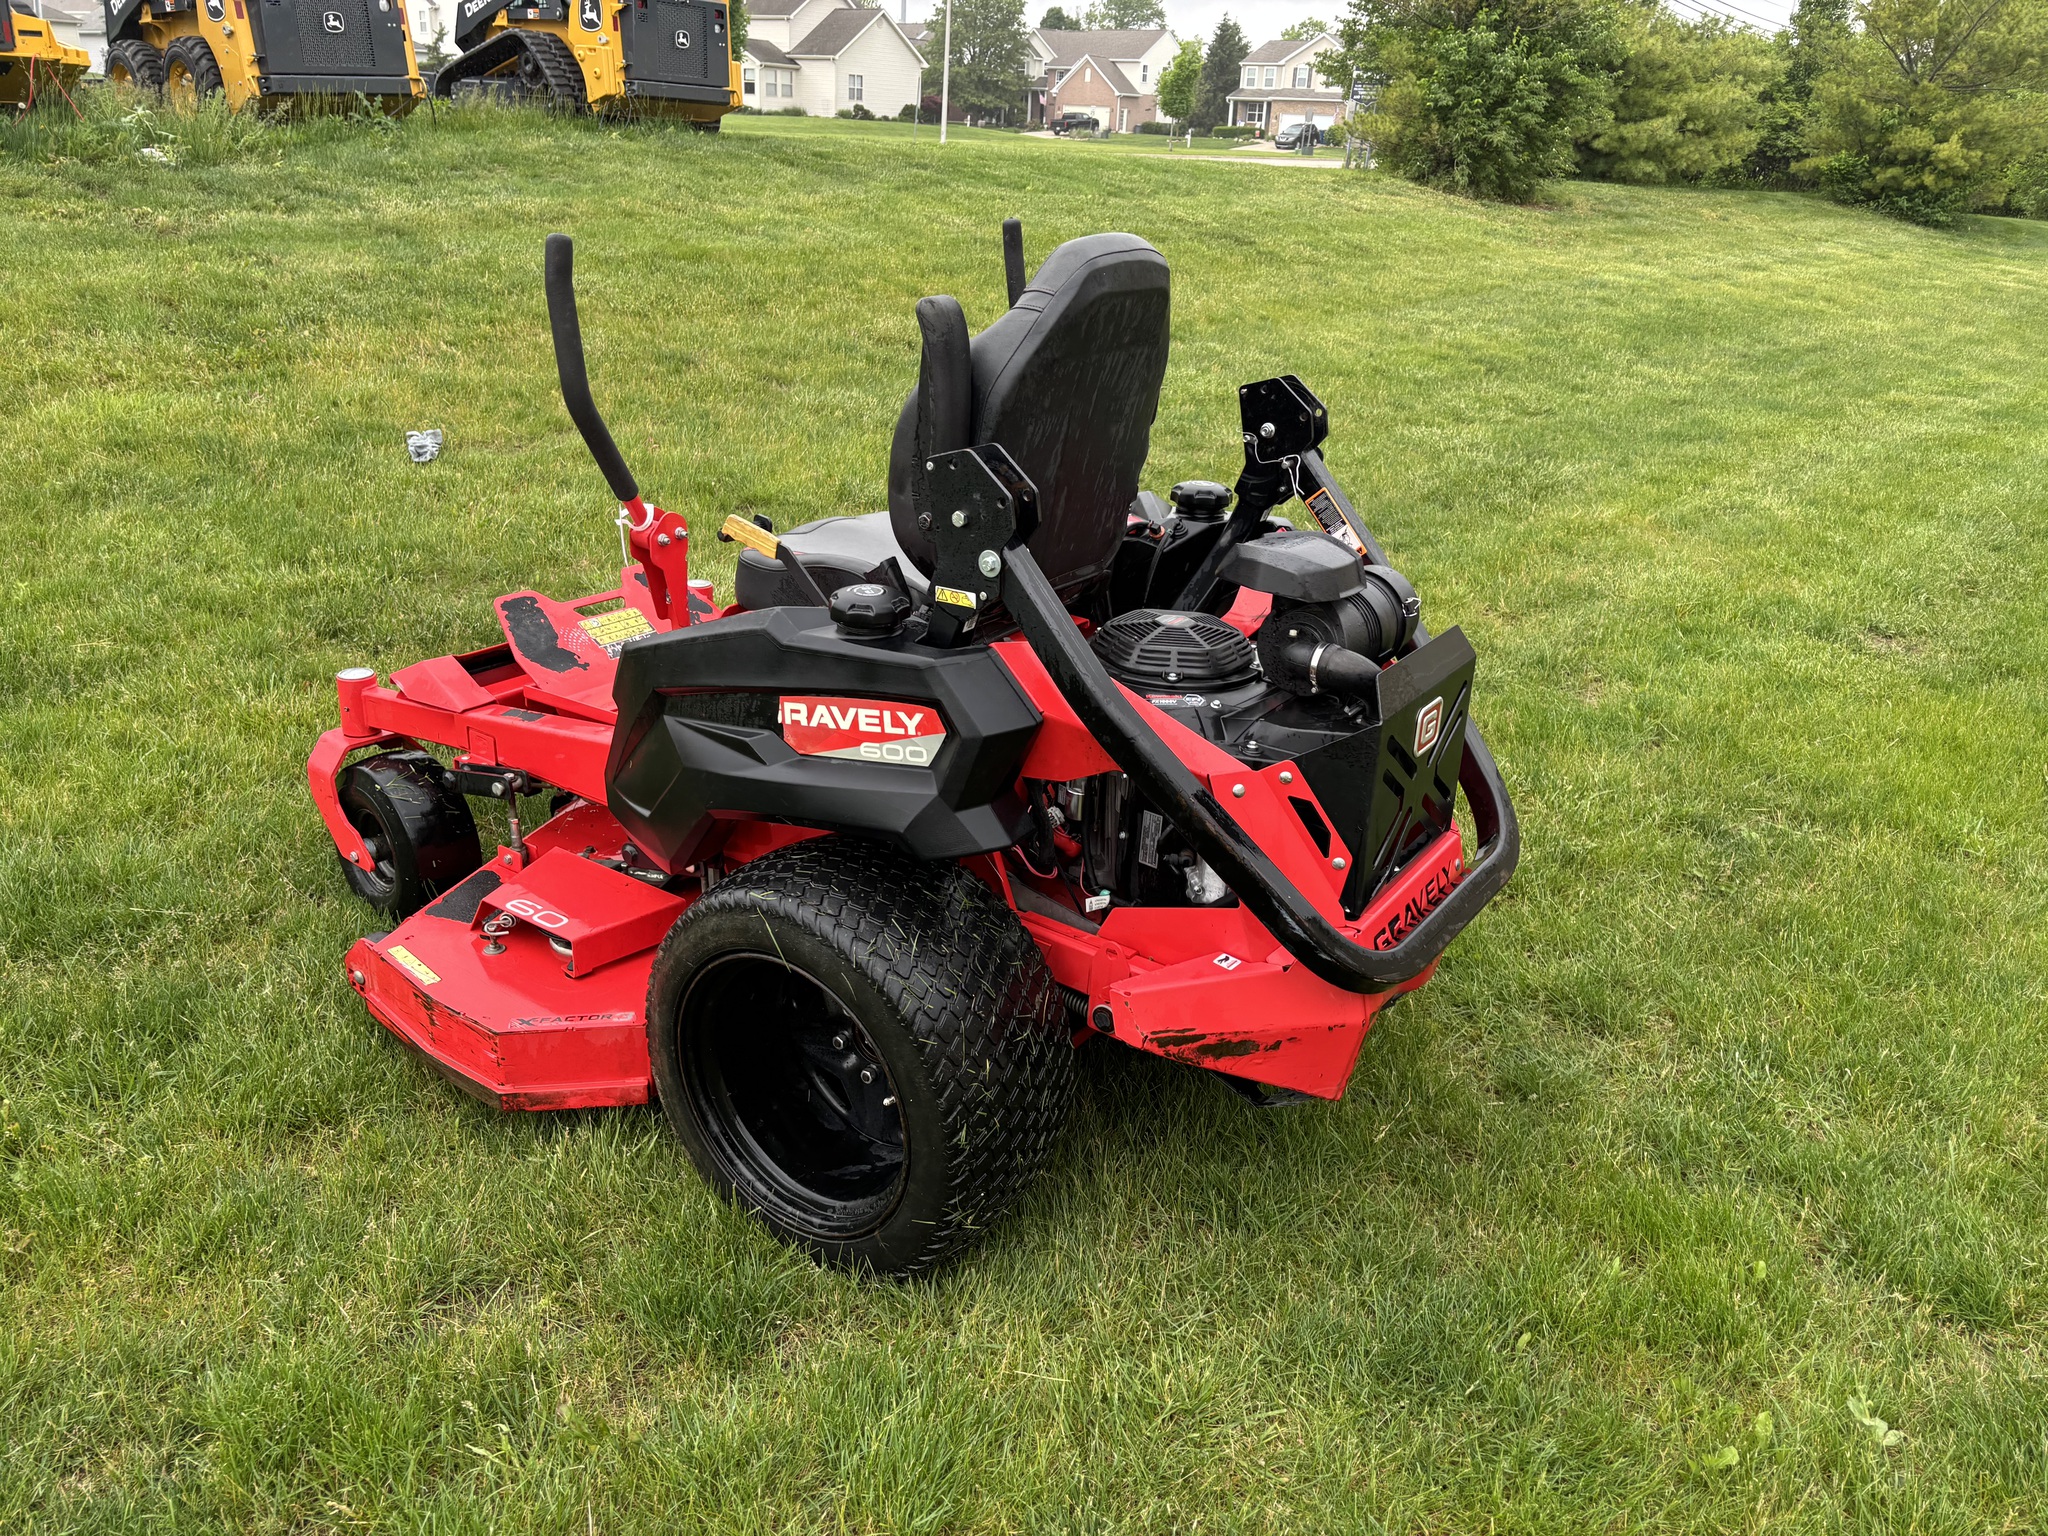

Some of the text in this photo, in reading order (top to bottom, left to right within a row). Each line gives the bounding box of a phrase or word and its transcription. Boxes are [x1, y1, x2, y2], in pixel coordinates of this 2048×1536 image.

[777, 701, 924, 736] RAVELY
[859, 742, 928, 762] 600
[505, 899, 569, 928] 60
